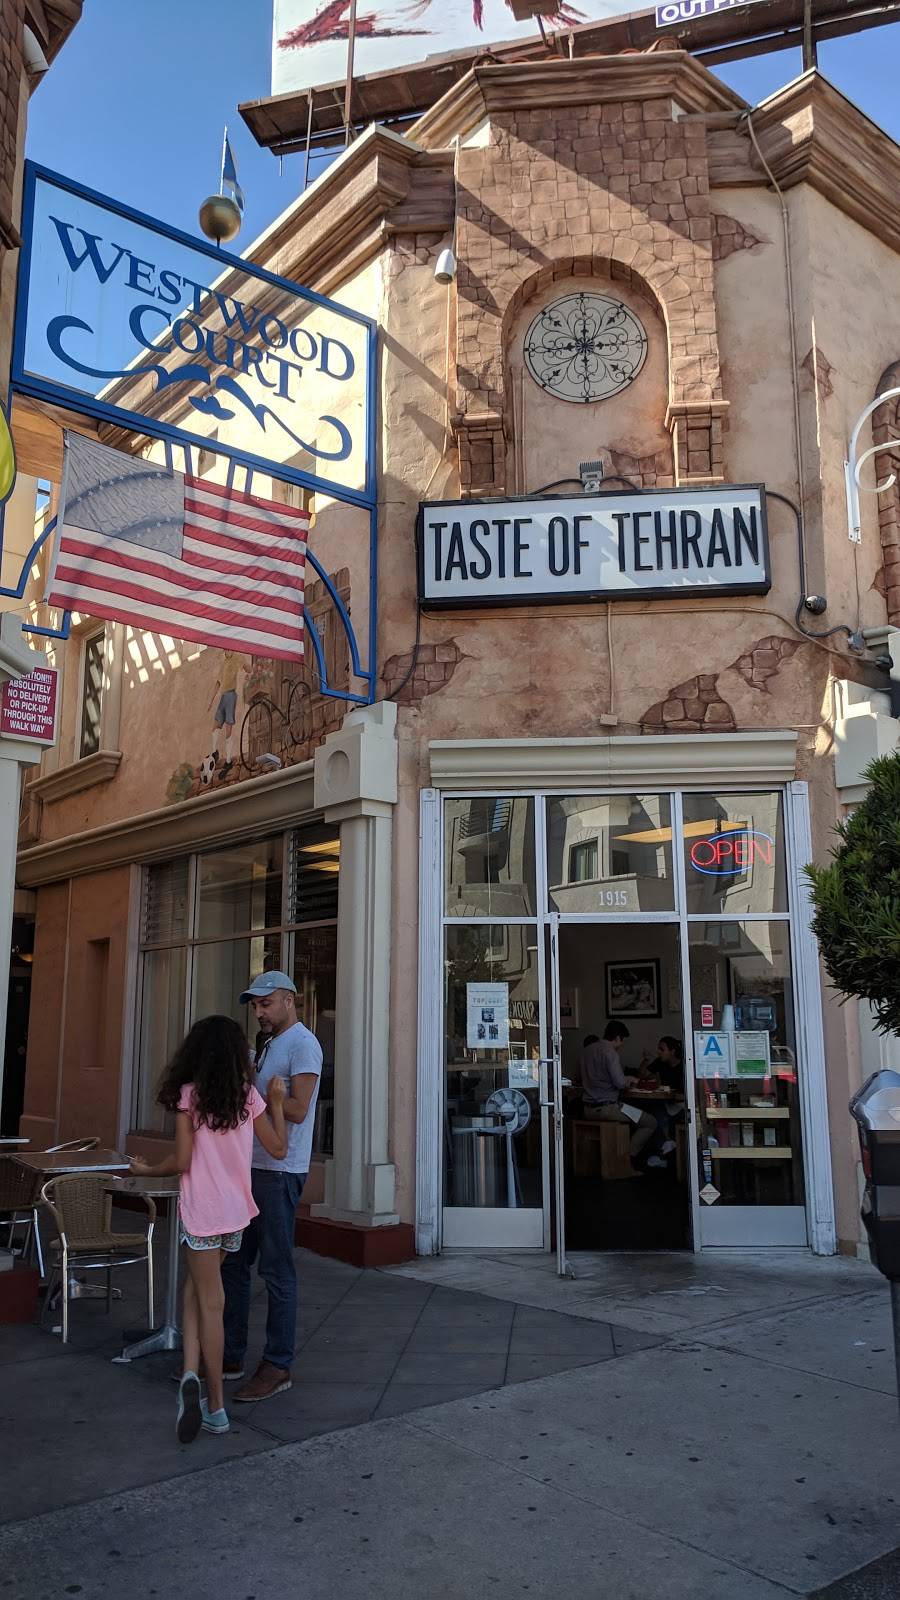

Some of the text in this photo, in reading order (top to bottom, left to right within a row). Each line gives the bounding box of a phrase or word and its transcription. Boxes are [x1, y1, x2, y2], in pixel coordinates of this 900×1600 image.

[49, 215, 356, 381] WESTWOOD
[128, 304, 303, 403] COURT
[429, 506, 760, 581] TASTE OF TEHRAN
[9, 680, 51, 694] ABSOLUTELY
[7, 689, 51, 704] NO DELIVERY
[9, 699, 48, 714] OR PICK-UP
[3, 708, 53, 726] THROUGH THIS
[9, 719, 45, 734] WALK WAY
[691, 840, 773, 867] OPEN
[598, 890, 628, 906] 1915
[703, 1035, 723, 1056] A
